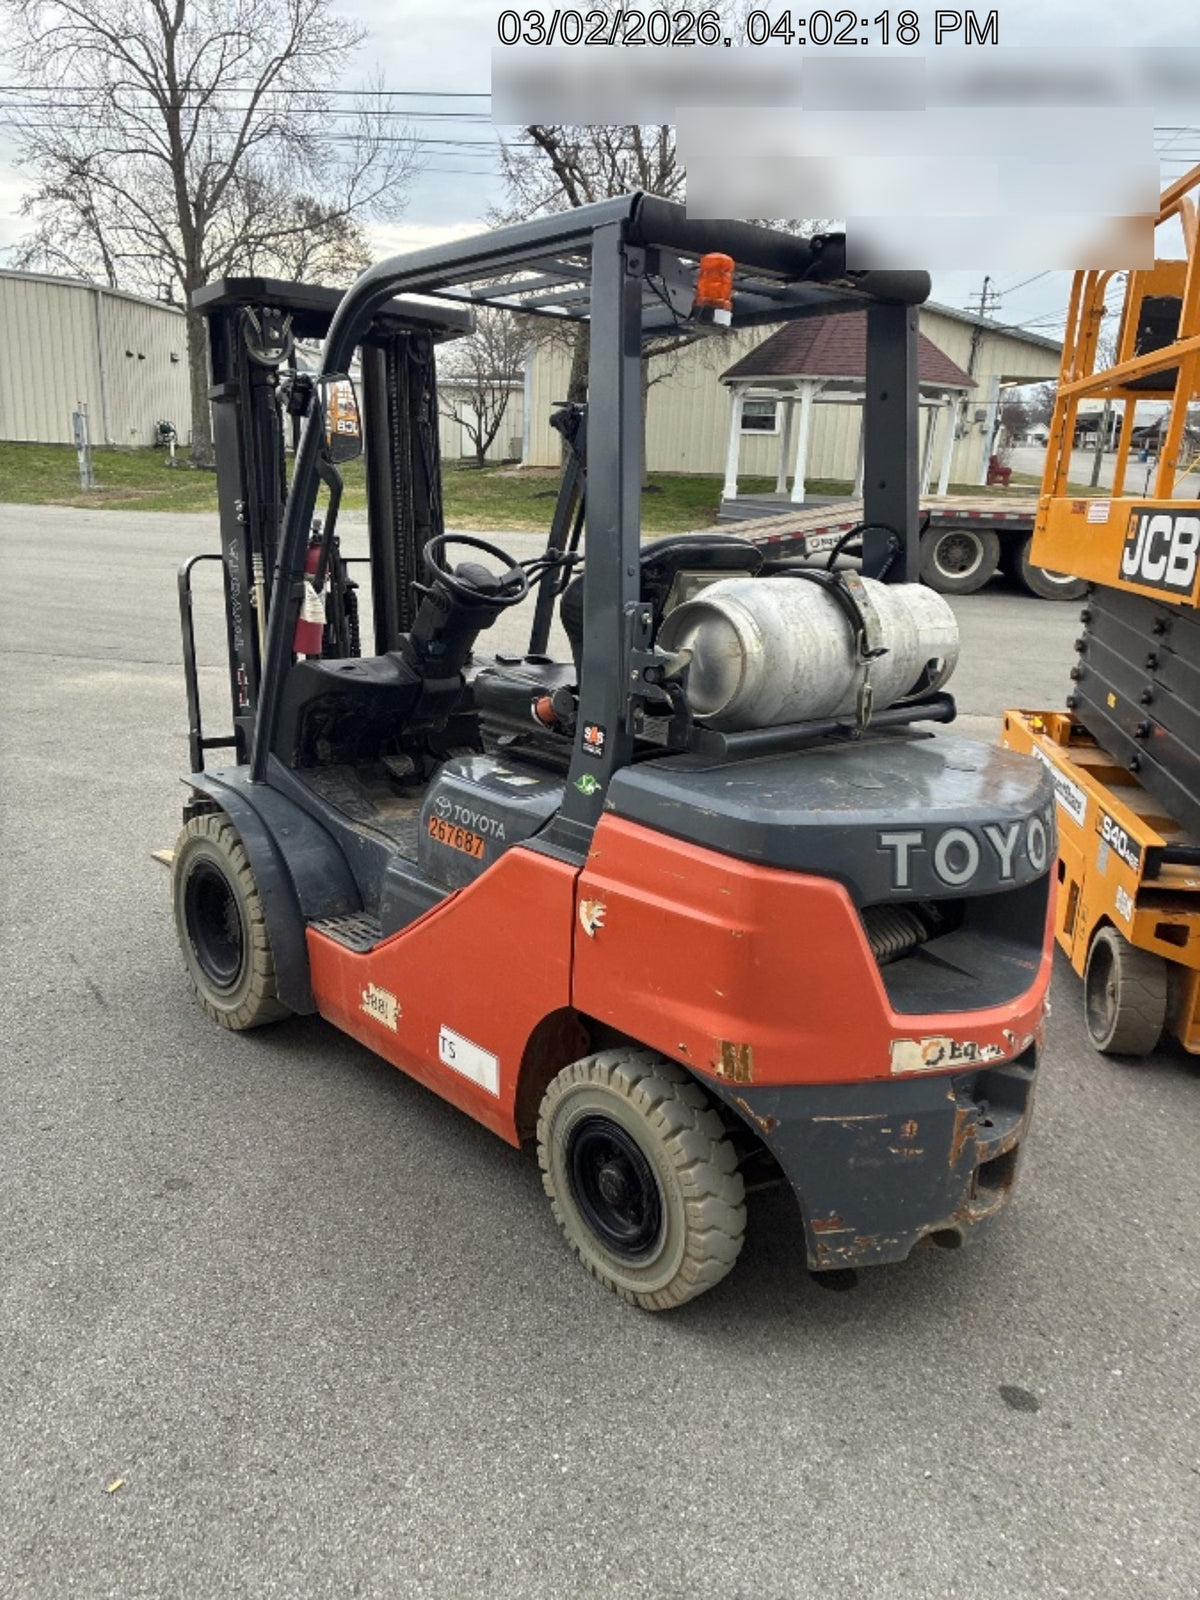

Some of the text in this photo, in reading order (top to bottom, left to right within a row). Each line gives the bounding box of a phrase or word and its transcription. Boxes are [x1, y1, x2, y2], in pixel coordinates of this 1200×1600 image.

[1121, 515, 1200, 587] JCB
[430, 817, 483, 856] 267687
[454, 805, 506, 840] TOYOTA
[880, 812, 1051, 886] TOYO
[440, 1036, 456, 1059] TS
